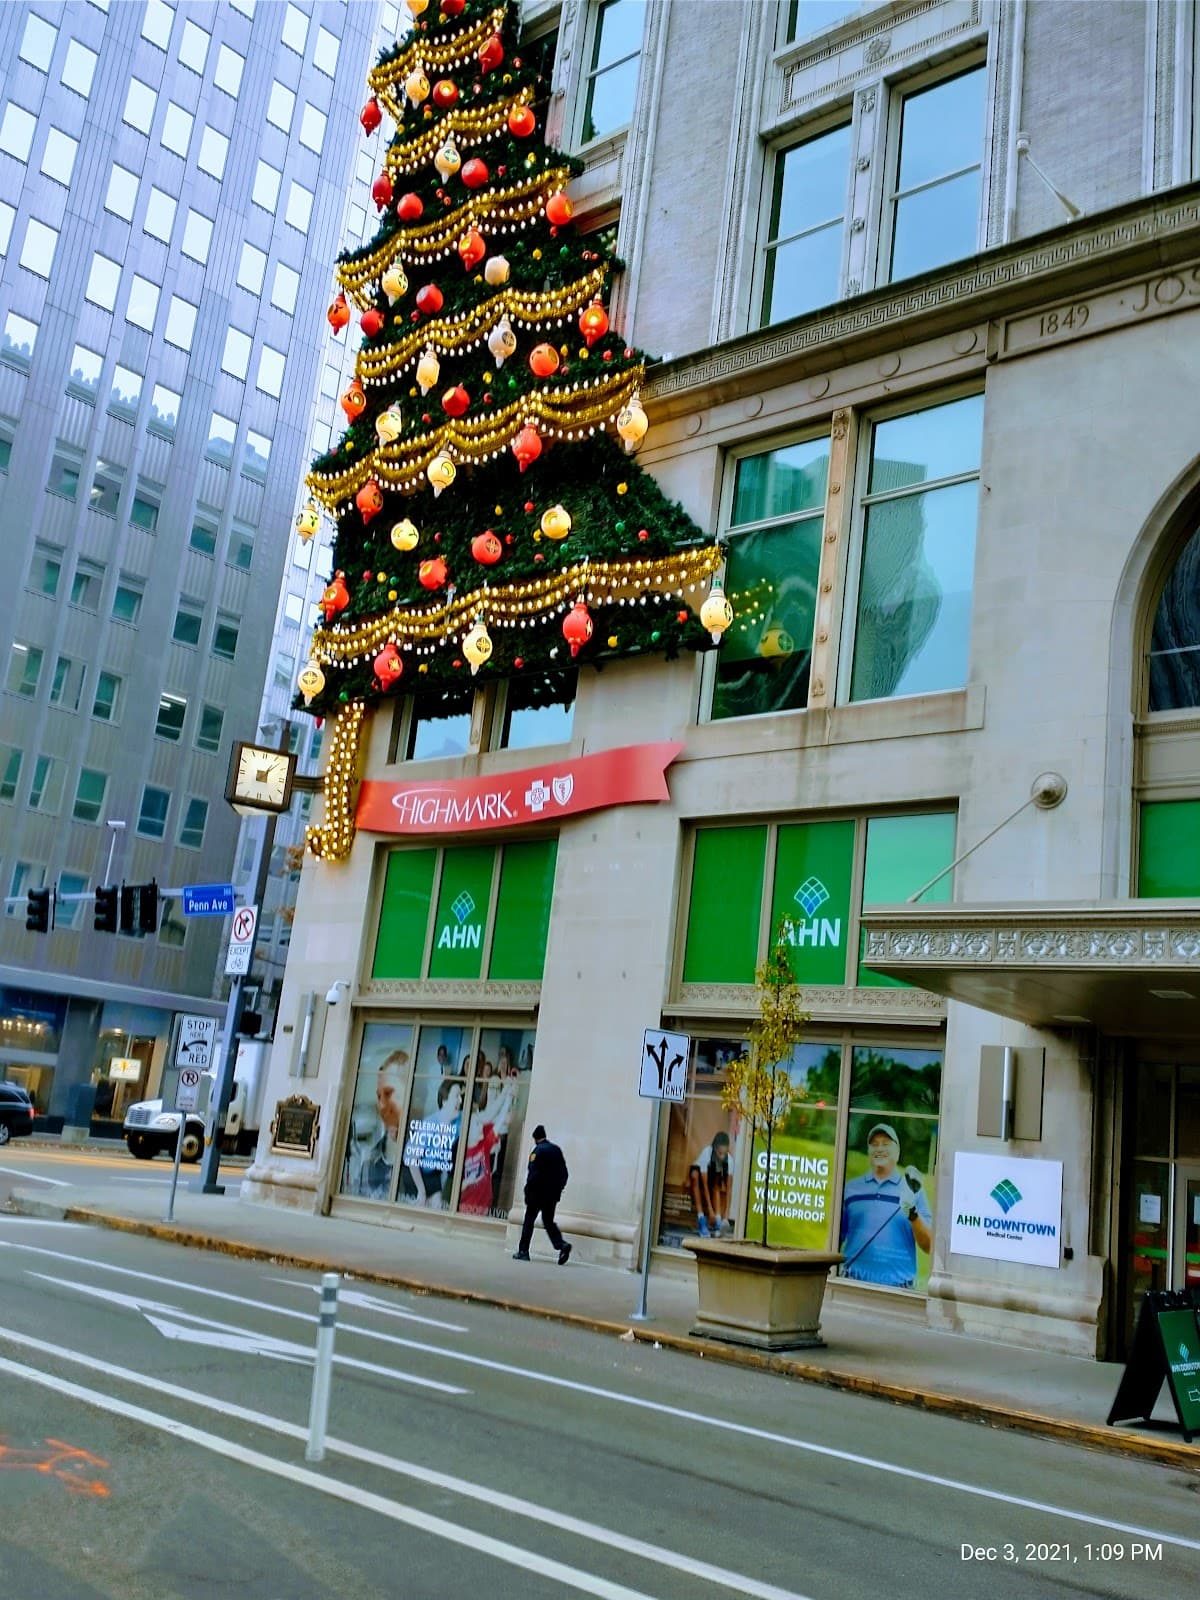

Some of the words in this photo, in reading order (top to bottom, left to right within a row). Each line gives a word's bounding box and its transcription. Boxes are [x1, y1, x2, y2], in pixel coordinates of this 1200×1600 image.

[1040, 304, 1089, 337] 1849
[392, 788, 513, 825] HIGHMARK
[189, 899, 209, 912] Penn
[211, 898, 228, 911] Ave
[438, 924, 481, 949] AHN
[777, 918, 841, 947] AHN
[187, 1019, 212, 1031] STOP
[189, 1054, 207, 1064] RED
[665, 1084, 683, 1097] ONLY
[410, 1119, 457, 1135] CELEBRATING
[409, 1131, 455, 1149] VICTORY
[406, 1147, 424, 1157] OVER
[425, 1148, 452, 1160] CANCER
[757, 1151, 829, 1176] GETTING
[782, 1175, 796, 1186] TO
[798, 1177, 828, 1191] WHAT
[781, 1190, 811, 1206] LOVE
[814, 1194, 825, 1208] IS
[956, 1214, 981, 1227] AHN
[983, 1217, 1056, 1237] DOWNTOWN
